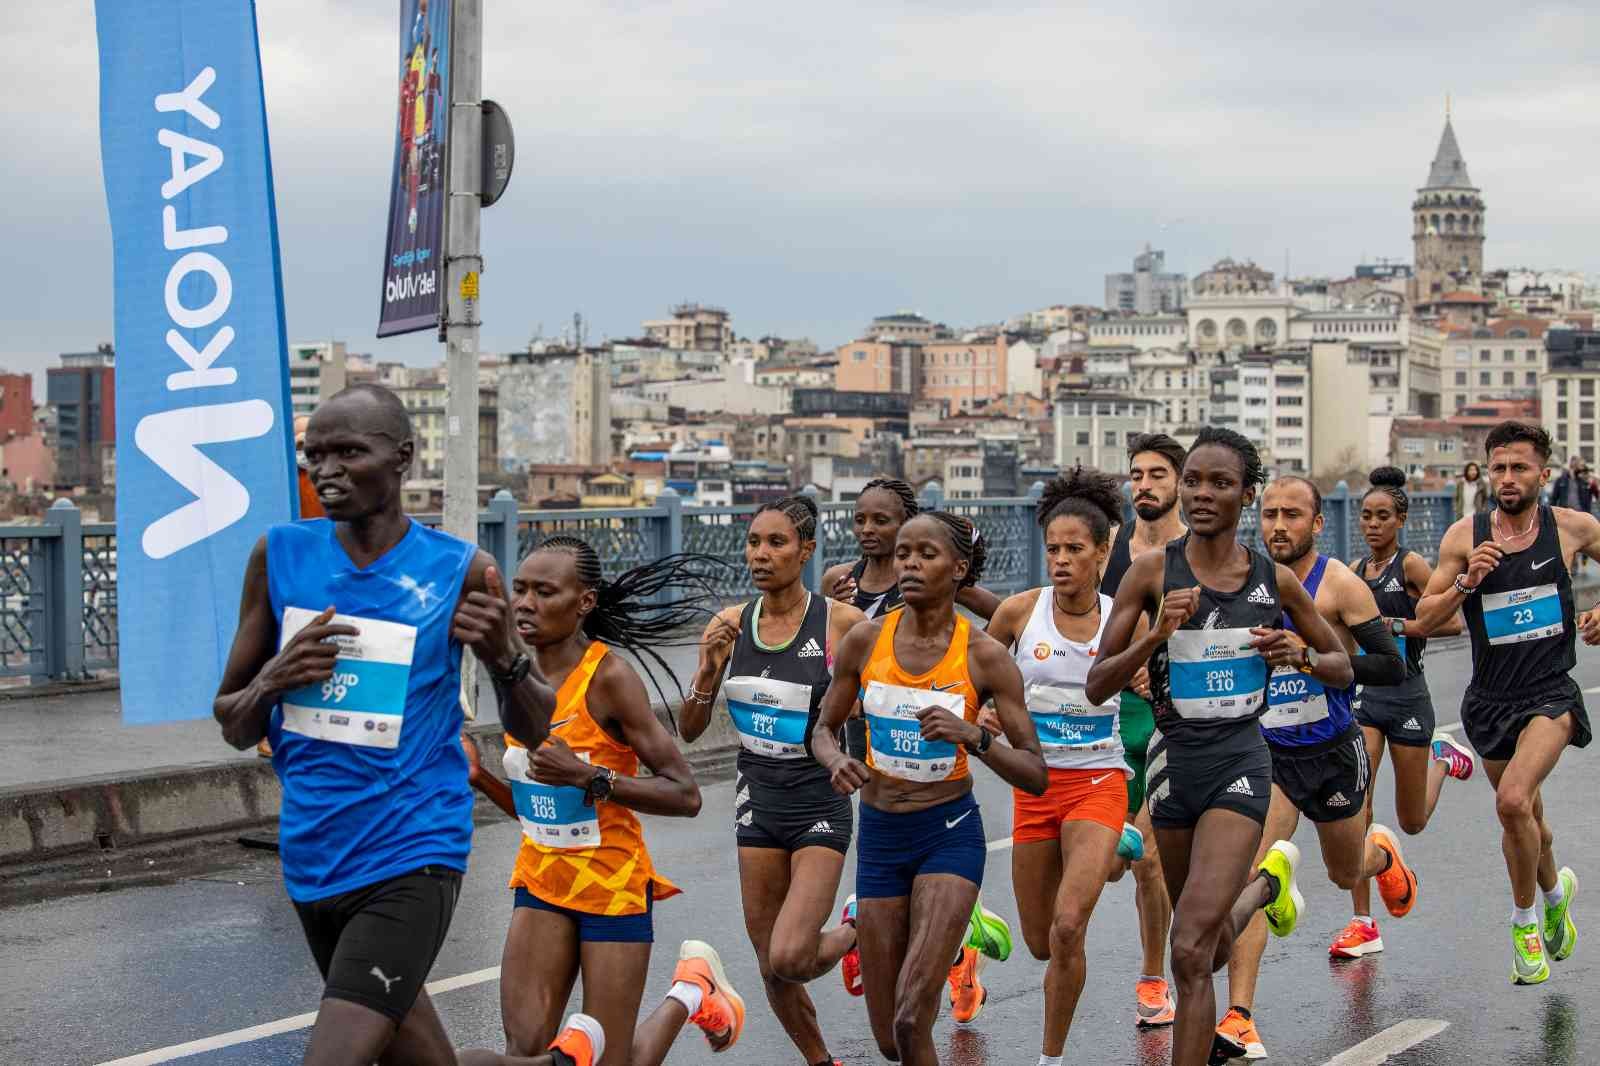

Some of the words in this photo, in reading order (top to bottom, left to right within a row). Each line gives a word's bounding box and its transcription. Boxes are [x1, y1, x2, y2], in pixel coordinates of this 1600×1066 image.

[1247, 595, 1275, 604] adidas
[1513, 608, 1534, 625] 23
[798, 648, 824, 657] adidas
[1053, 649, 1066, 657] NN
[1206, 668, 1234, 681] JOAN
[1206, 678, 1234, 692] 110
[1270, 679, 1308, 697] 5402
[322, 684, 348, 703] 99
[753, 720, 773, 737] 114
[1060, 728, 1082, 740] 104
[893, 738, 921, 755] 101
[1227, 785, 1254, 797] adidas
[530, 794, 556, 807] RUTH
[533, 803, 557, 820] 103
